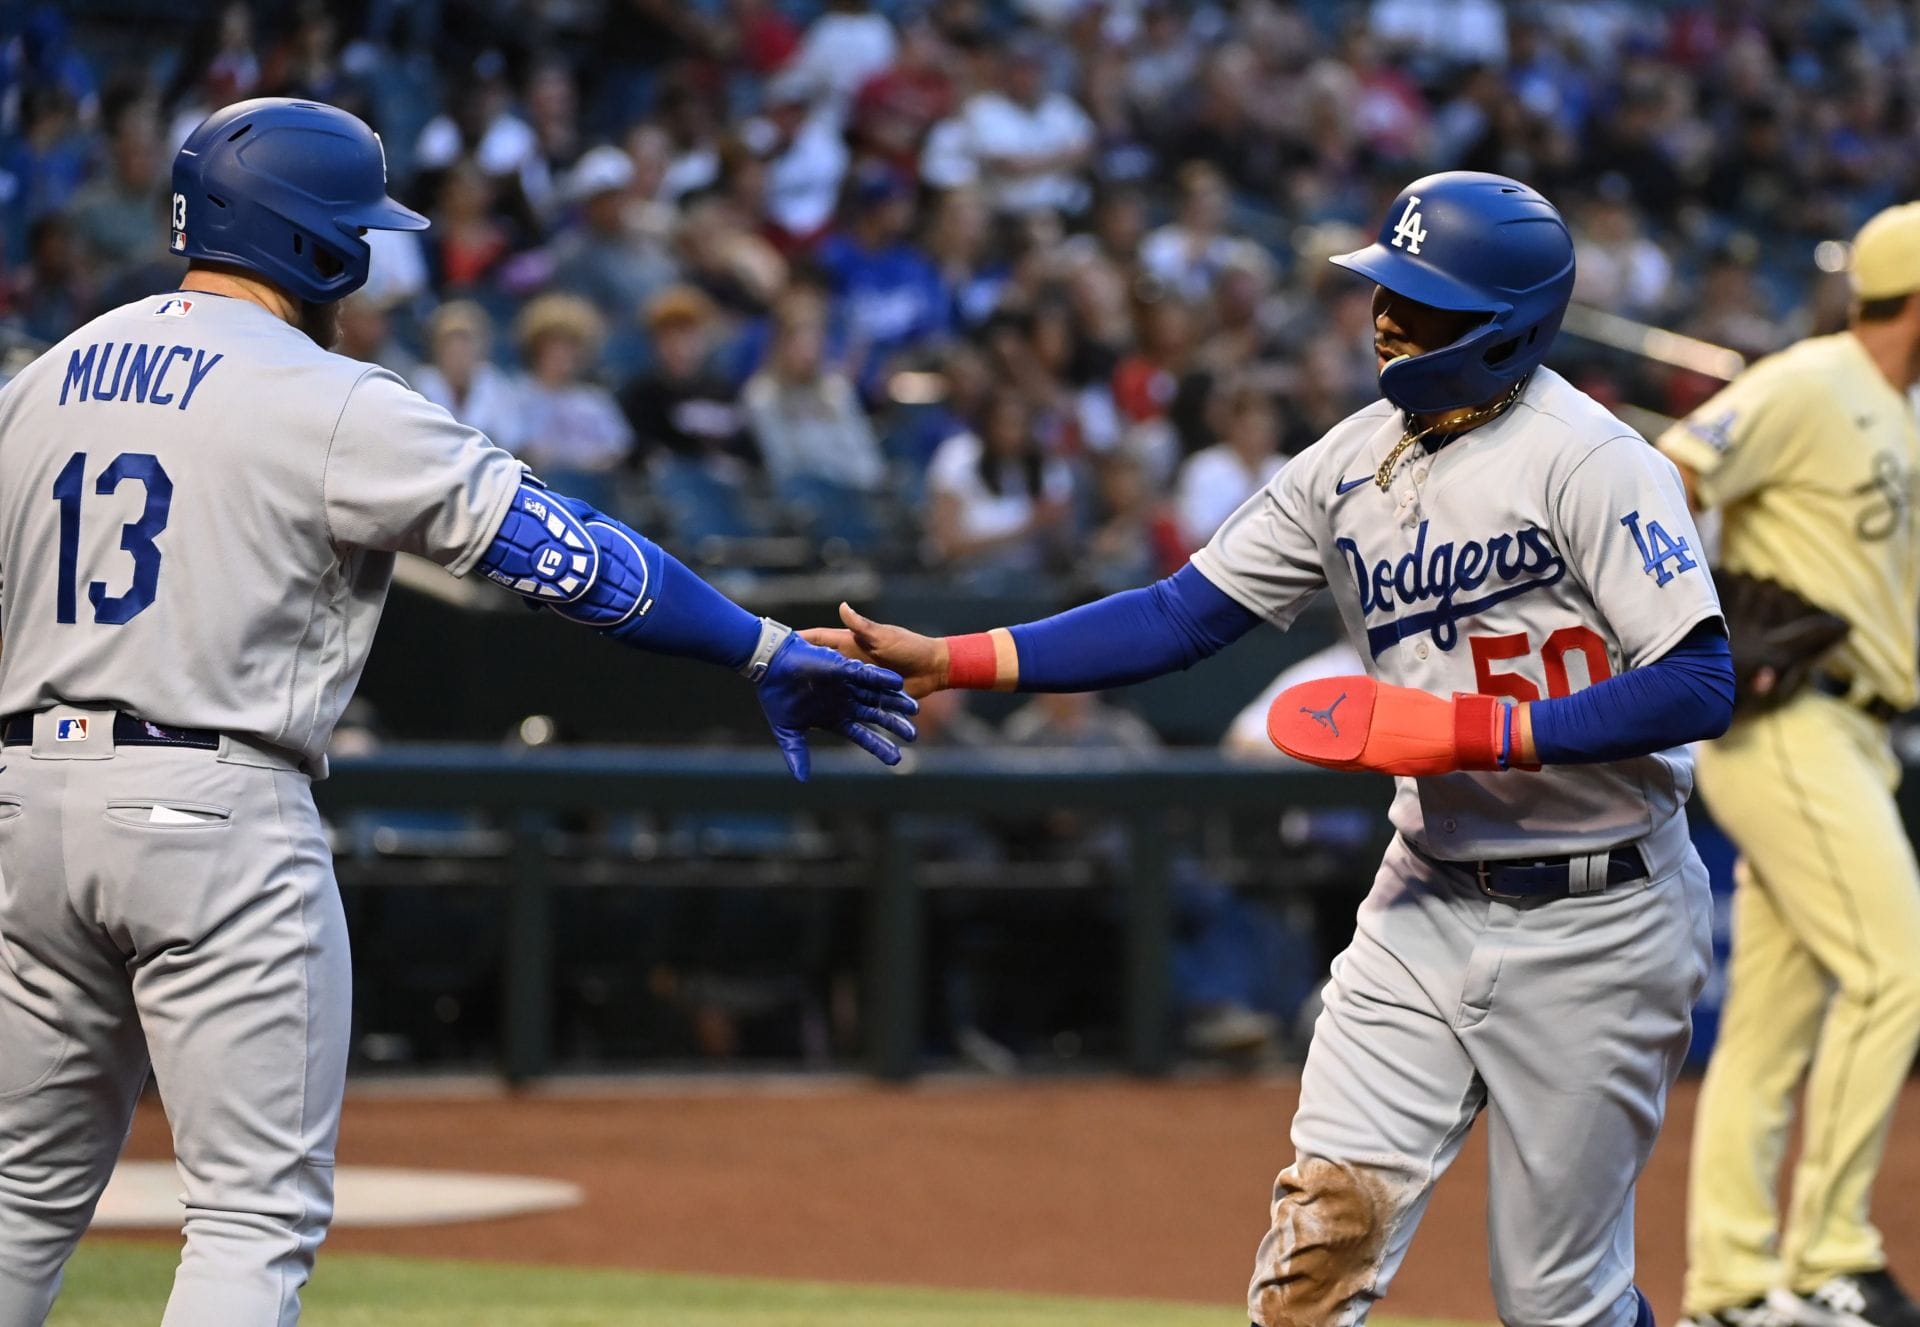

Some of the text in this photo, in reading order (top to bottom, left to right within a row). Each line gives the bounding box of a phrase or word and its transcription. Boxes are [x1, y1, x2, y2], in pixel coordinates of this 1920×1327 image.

[172, 192, 187, 231] 13
[1391, 195, 1428, 255] LA
[59, 343, 224, 410] MUNCY
[53, 451, 173, 625] 13
[1620, 511, 1698, 588] LA
[1336, 519, 1566, 655] Dodgers
[1469, 625, 1612, 701] 50
